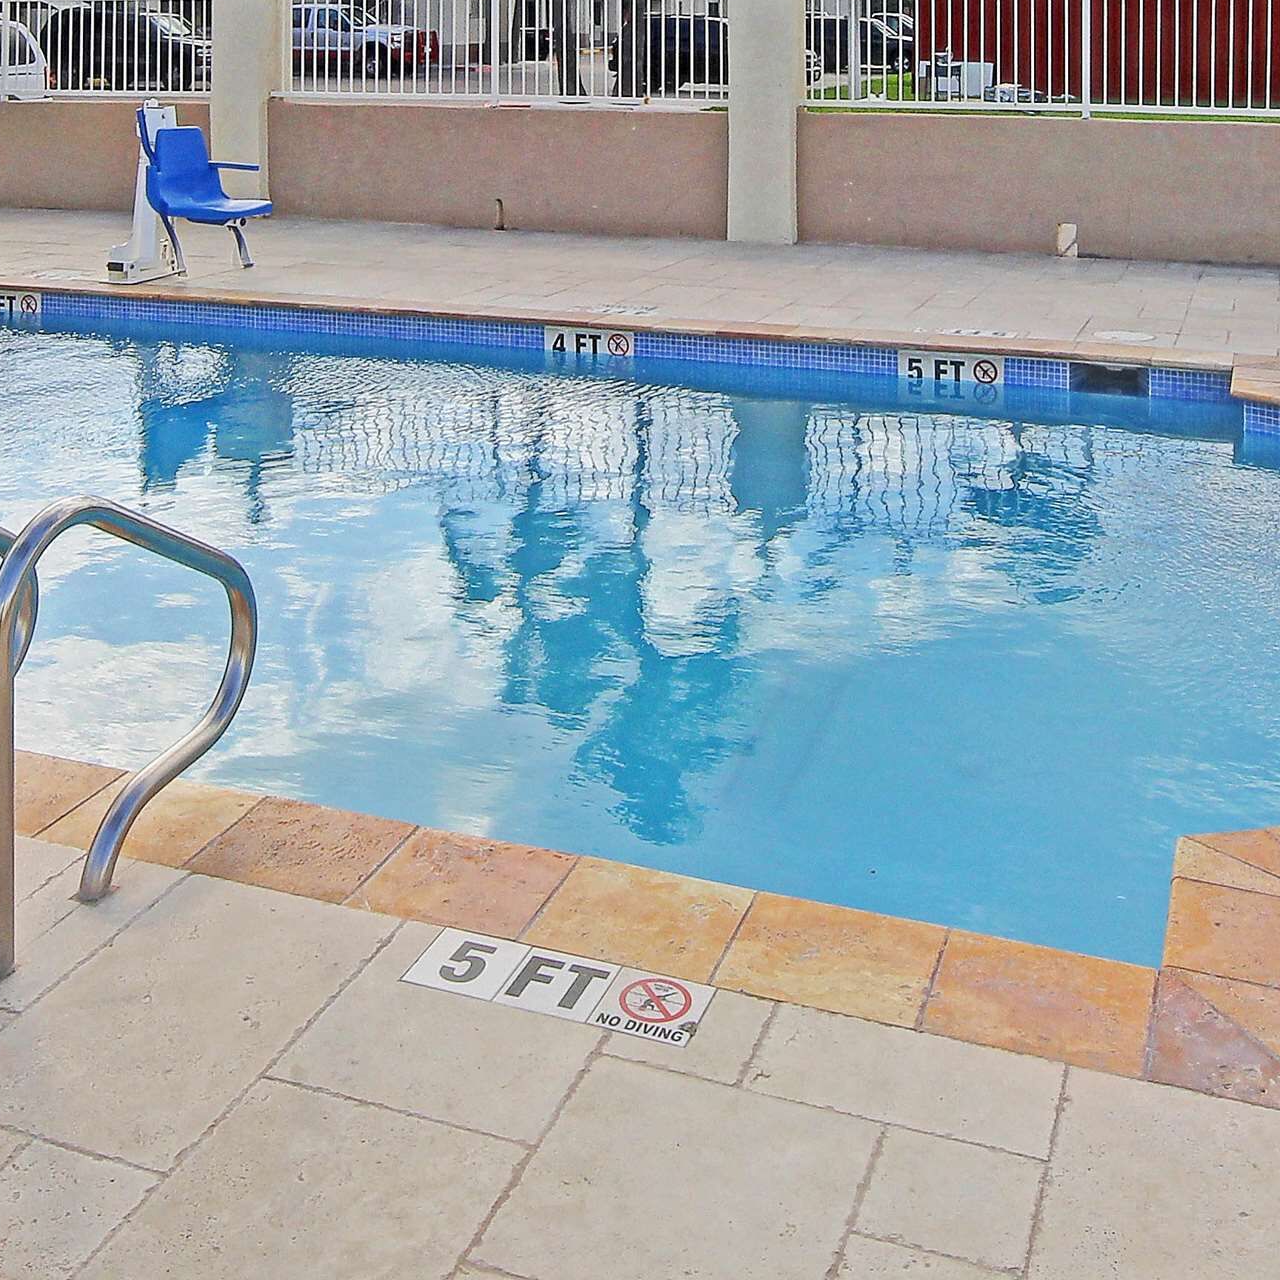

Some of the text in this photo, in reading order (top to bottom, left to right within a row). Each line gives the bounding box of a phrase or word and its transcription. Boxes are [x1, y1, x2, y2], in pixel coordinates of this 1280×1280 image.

[552, 333, 601, 354] 4 FT
[908, 358, 965, 382] 5 FT
[439, 941, 611, 1010] 5 FT
[596, 1012, 684, 1042] NO DIVING
